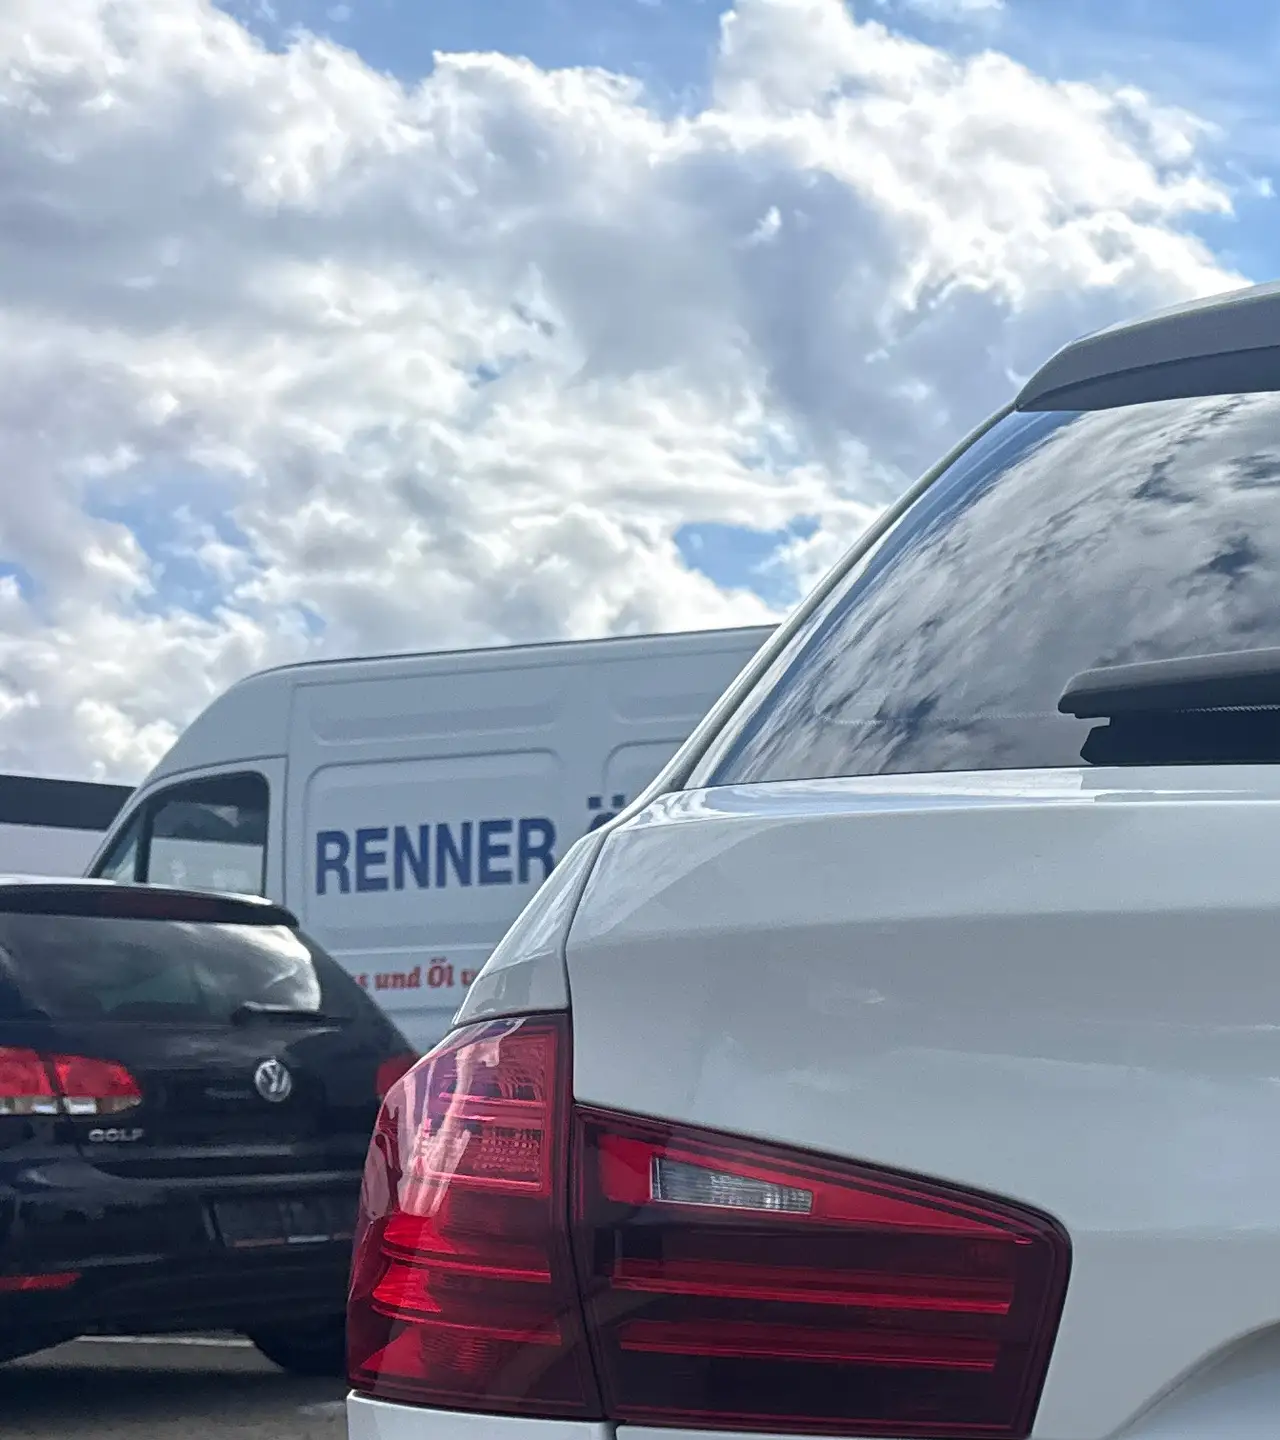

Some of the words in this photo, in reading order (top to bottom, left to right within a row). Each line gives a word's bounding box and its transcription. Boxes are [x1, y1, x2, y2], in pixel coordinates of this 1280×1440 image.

[316, 817, 557, 895] RENNER
[375, 966, 421, 990] und
[427, 956, 455, 987] Öl
[89, 1128, 143, 1142] GOLF
